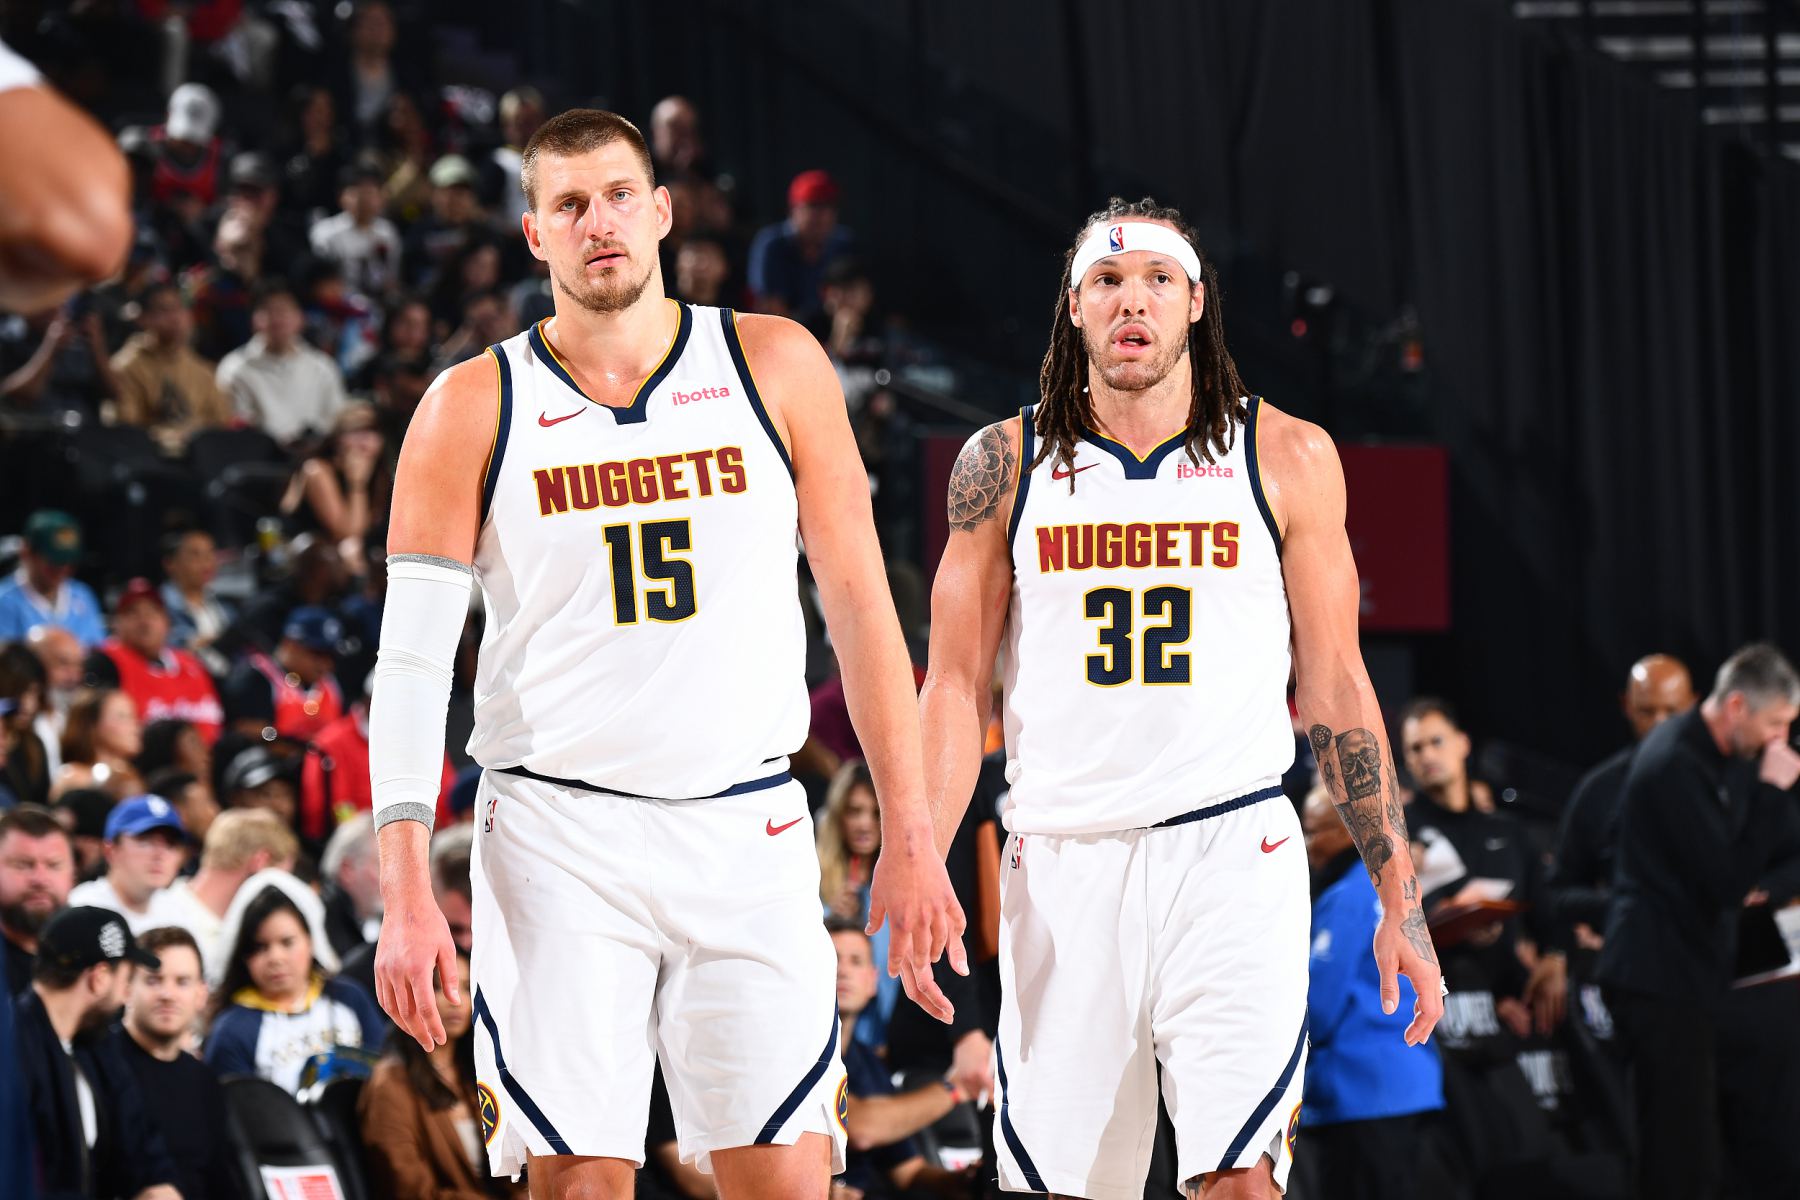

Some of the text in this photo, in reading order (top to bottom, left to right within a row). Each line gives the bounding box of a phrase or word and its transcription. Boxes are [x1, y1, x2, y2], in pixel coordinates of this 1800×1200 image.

[671, 387, 730, 406] ibotta
[533, 447, 747, 517] NUGGETS
[1177, 463, 1234, 479] ibotta
[602, 518, 697, 626] 15
[1036, 521, 1240, 574] NUGGETS
[1084, 584, 1192, 688] 32
